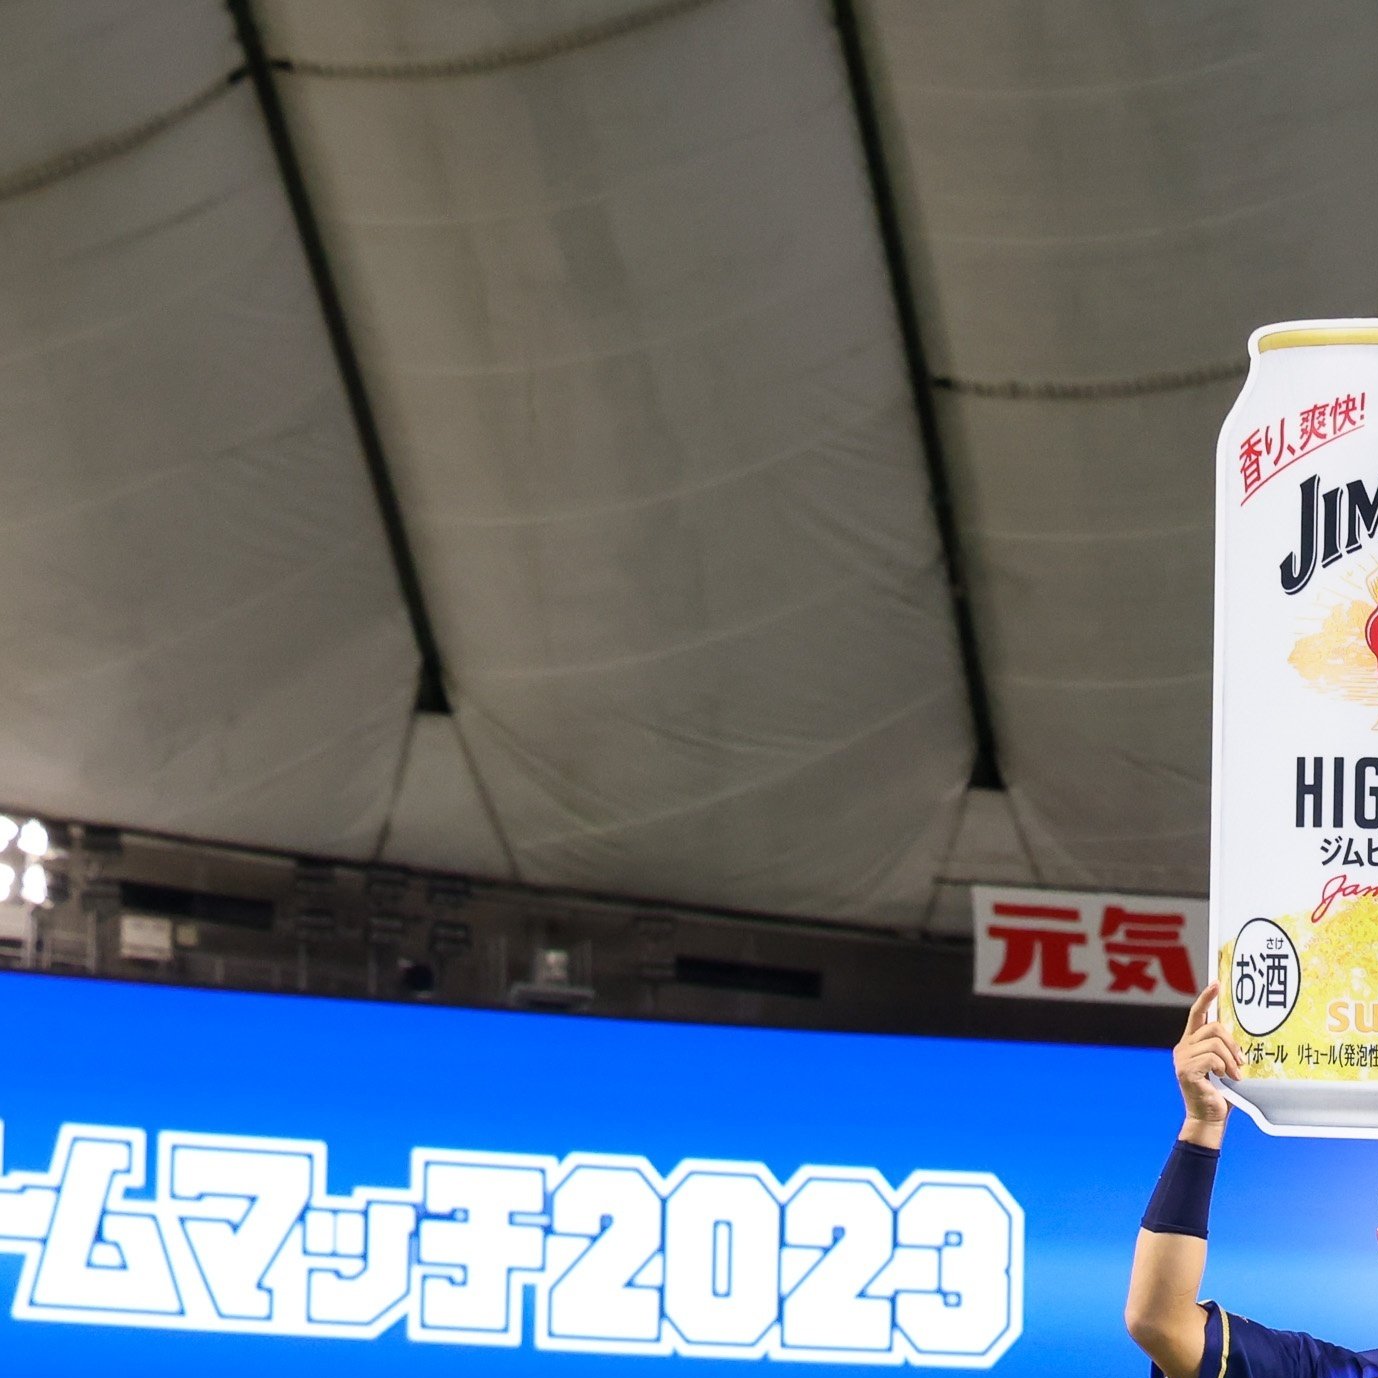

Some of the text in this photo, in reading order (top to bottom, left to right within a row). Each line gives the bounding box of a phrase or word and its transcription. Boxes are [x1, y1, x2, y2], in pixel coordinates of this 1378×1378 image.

[1266, 937, 1284, 950] さけ
[1236, 953, 1290, 1009] お酒
[1240, 1044, 1289, 1066] イボール
